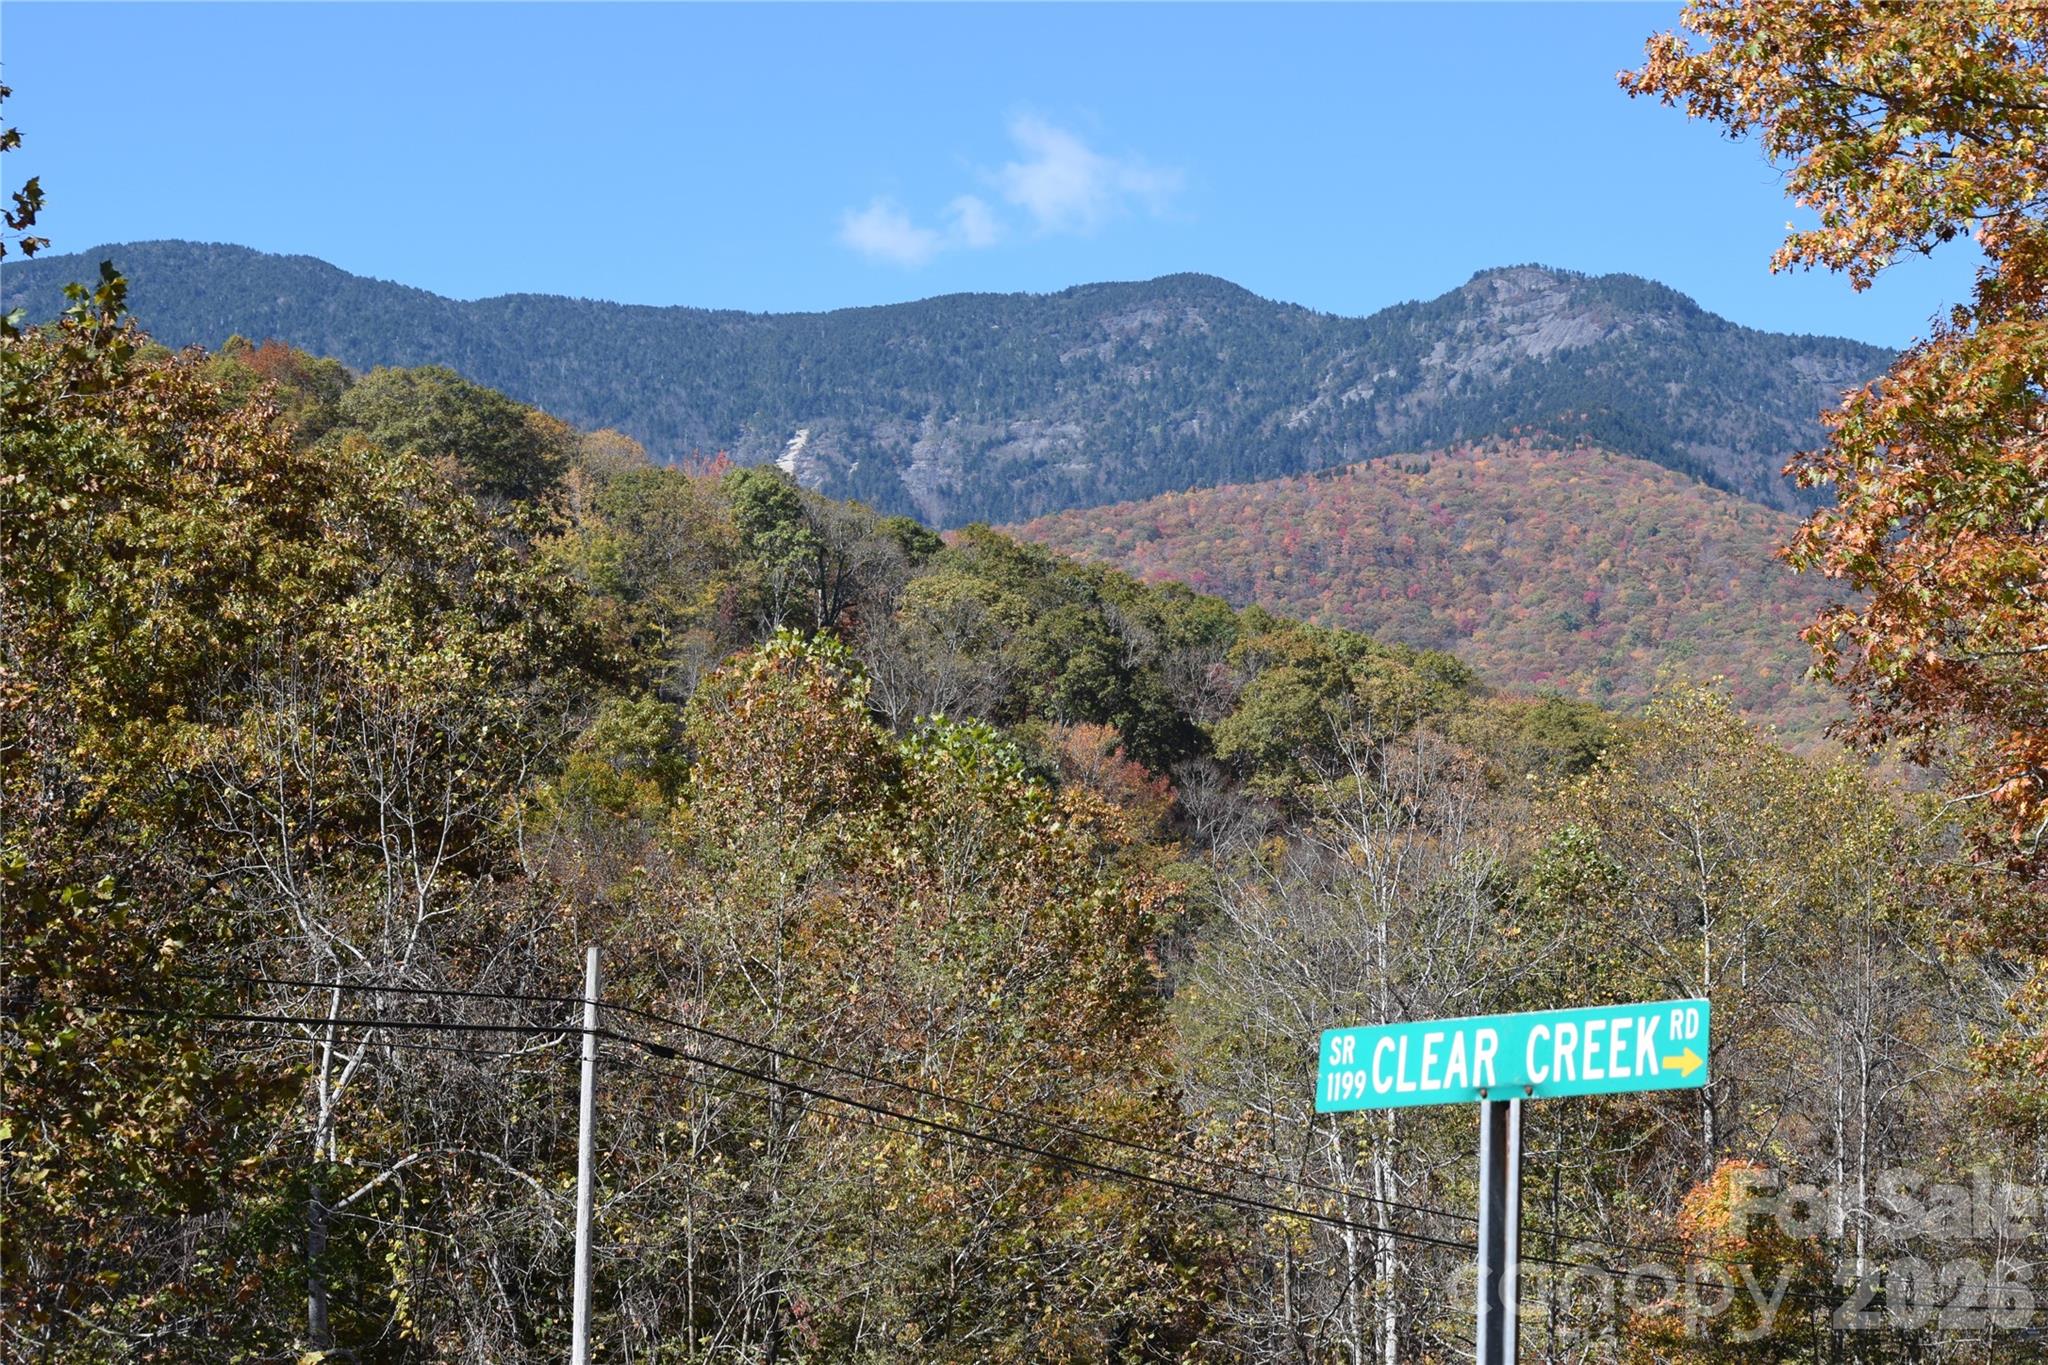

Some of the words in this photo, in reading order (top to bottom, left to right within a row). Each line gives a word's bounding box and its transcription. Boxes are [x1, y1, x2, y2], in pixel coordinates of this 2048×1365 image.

[1329, 1035, 1355, 1065] SR
[1372, 1028, 1498, 1094] CLEAR
[1526, 1015, 1661, 1084] CREEK
[1669, 1008, 1699, 1041] RD
[1326, 1070, 1366, 1101] 1199
